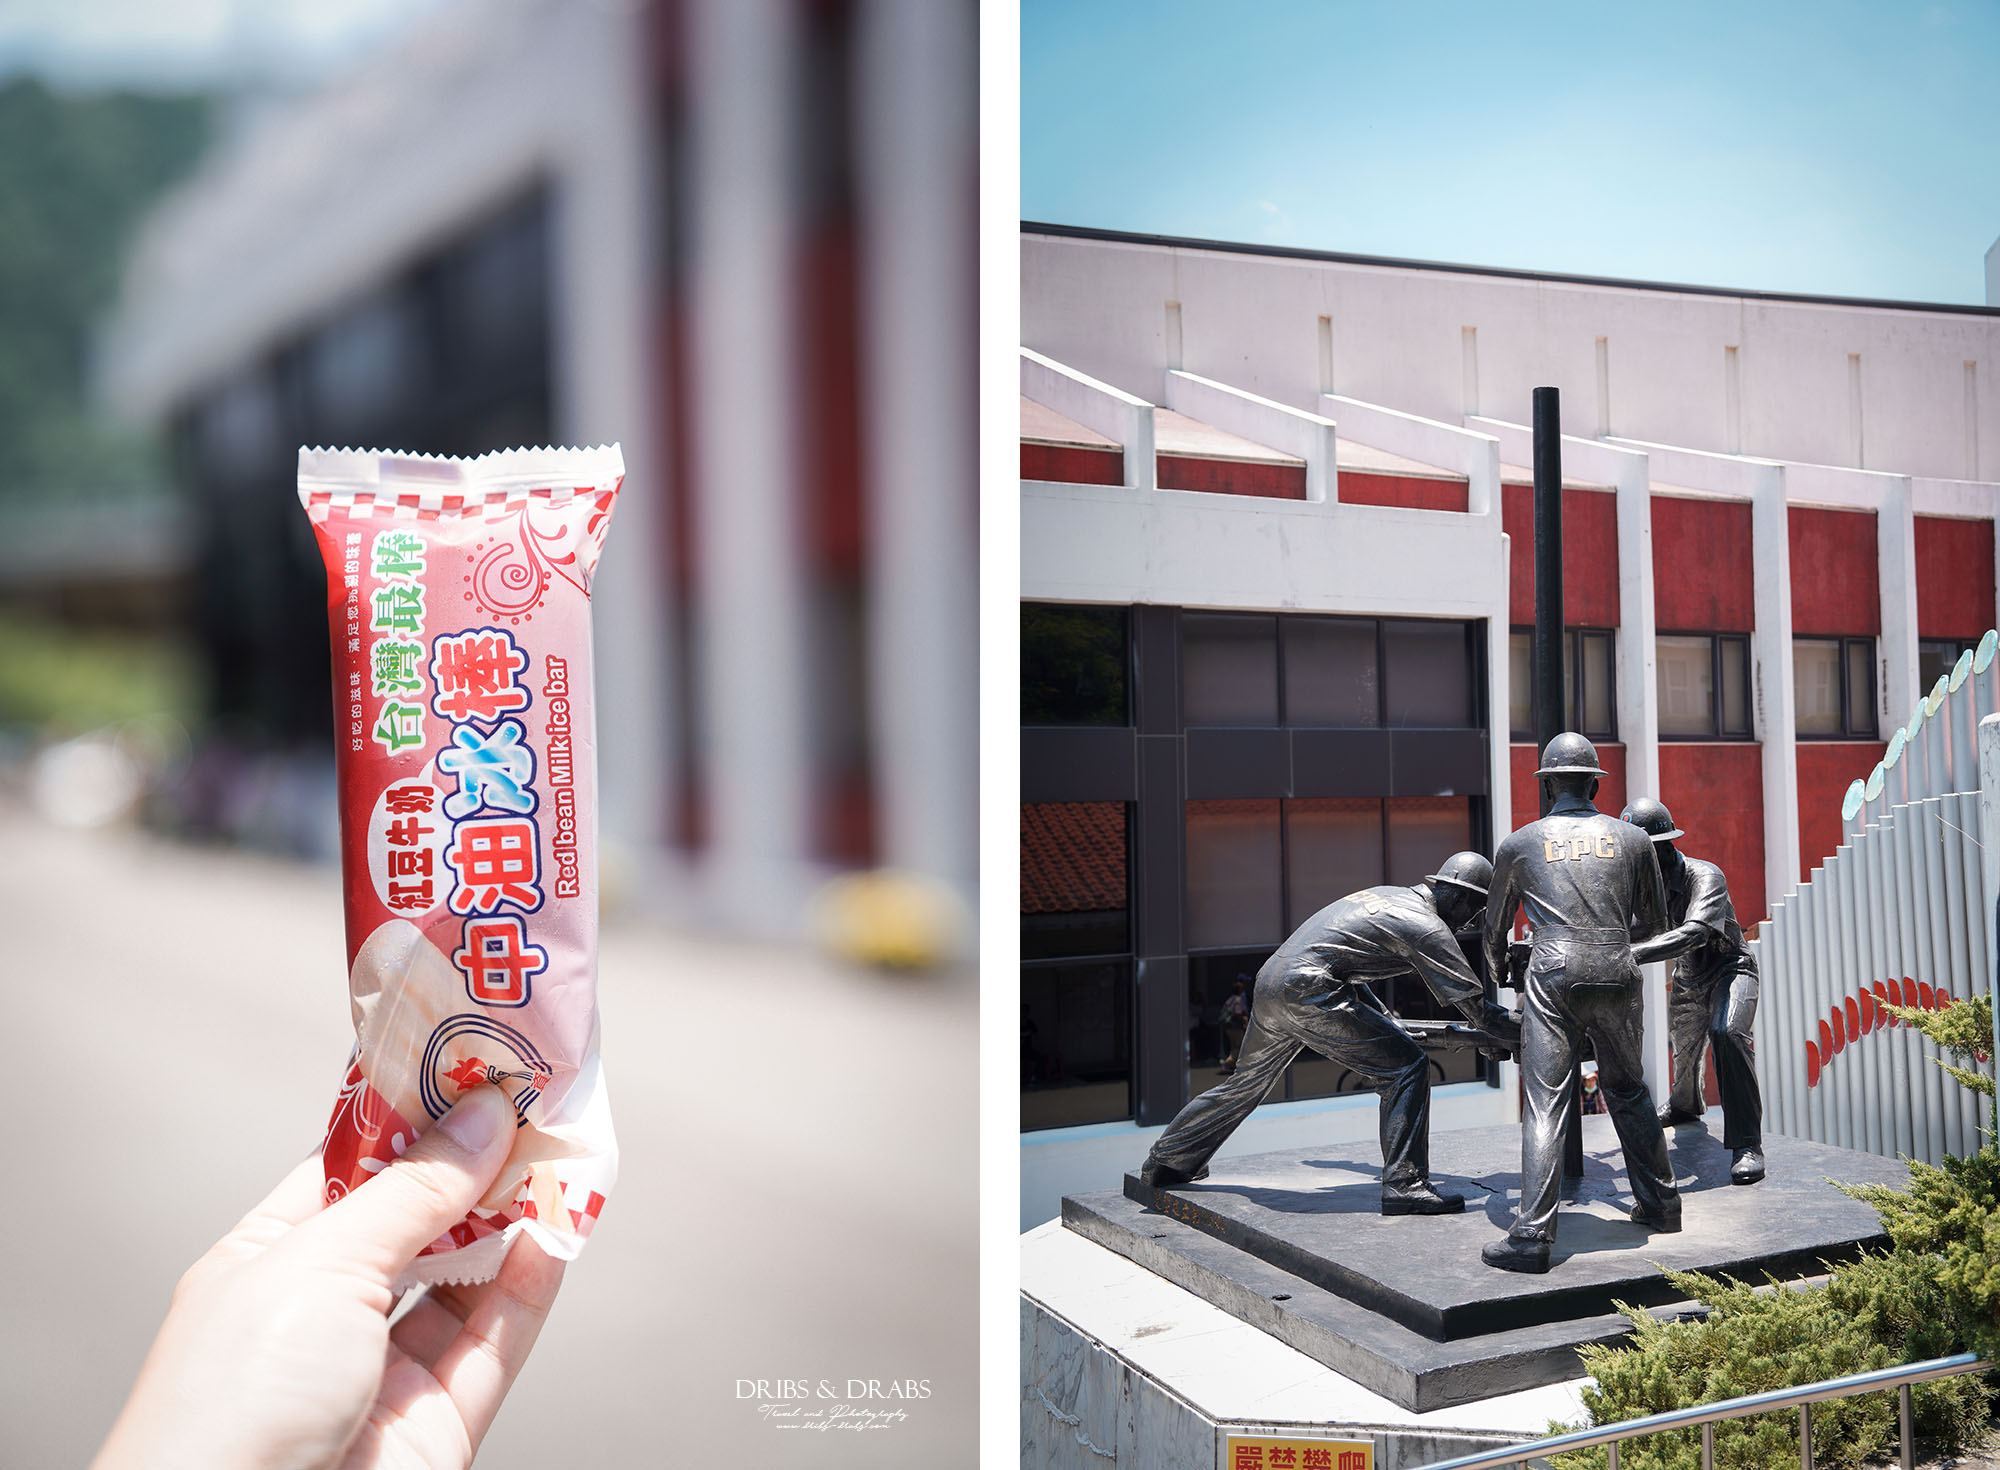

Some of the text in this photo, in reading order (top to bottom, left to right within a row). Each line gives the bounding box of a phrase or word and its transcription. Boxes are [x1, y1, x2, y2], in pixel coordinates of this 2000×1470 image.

[372, 530, 426, 754] 台灣最棒
[385, 785, 435, 911] 紅豆牛奶
[431, 629, 546, 1004] 中油冰棒
[545, 656, 578, 897] Red bean Milk ice bar
[1543, 835, 1615, 863] CPC
